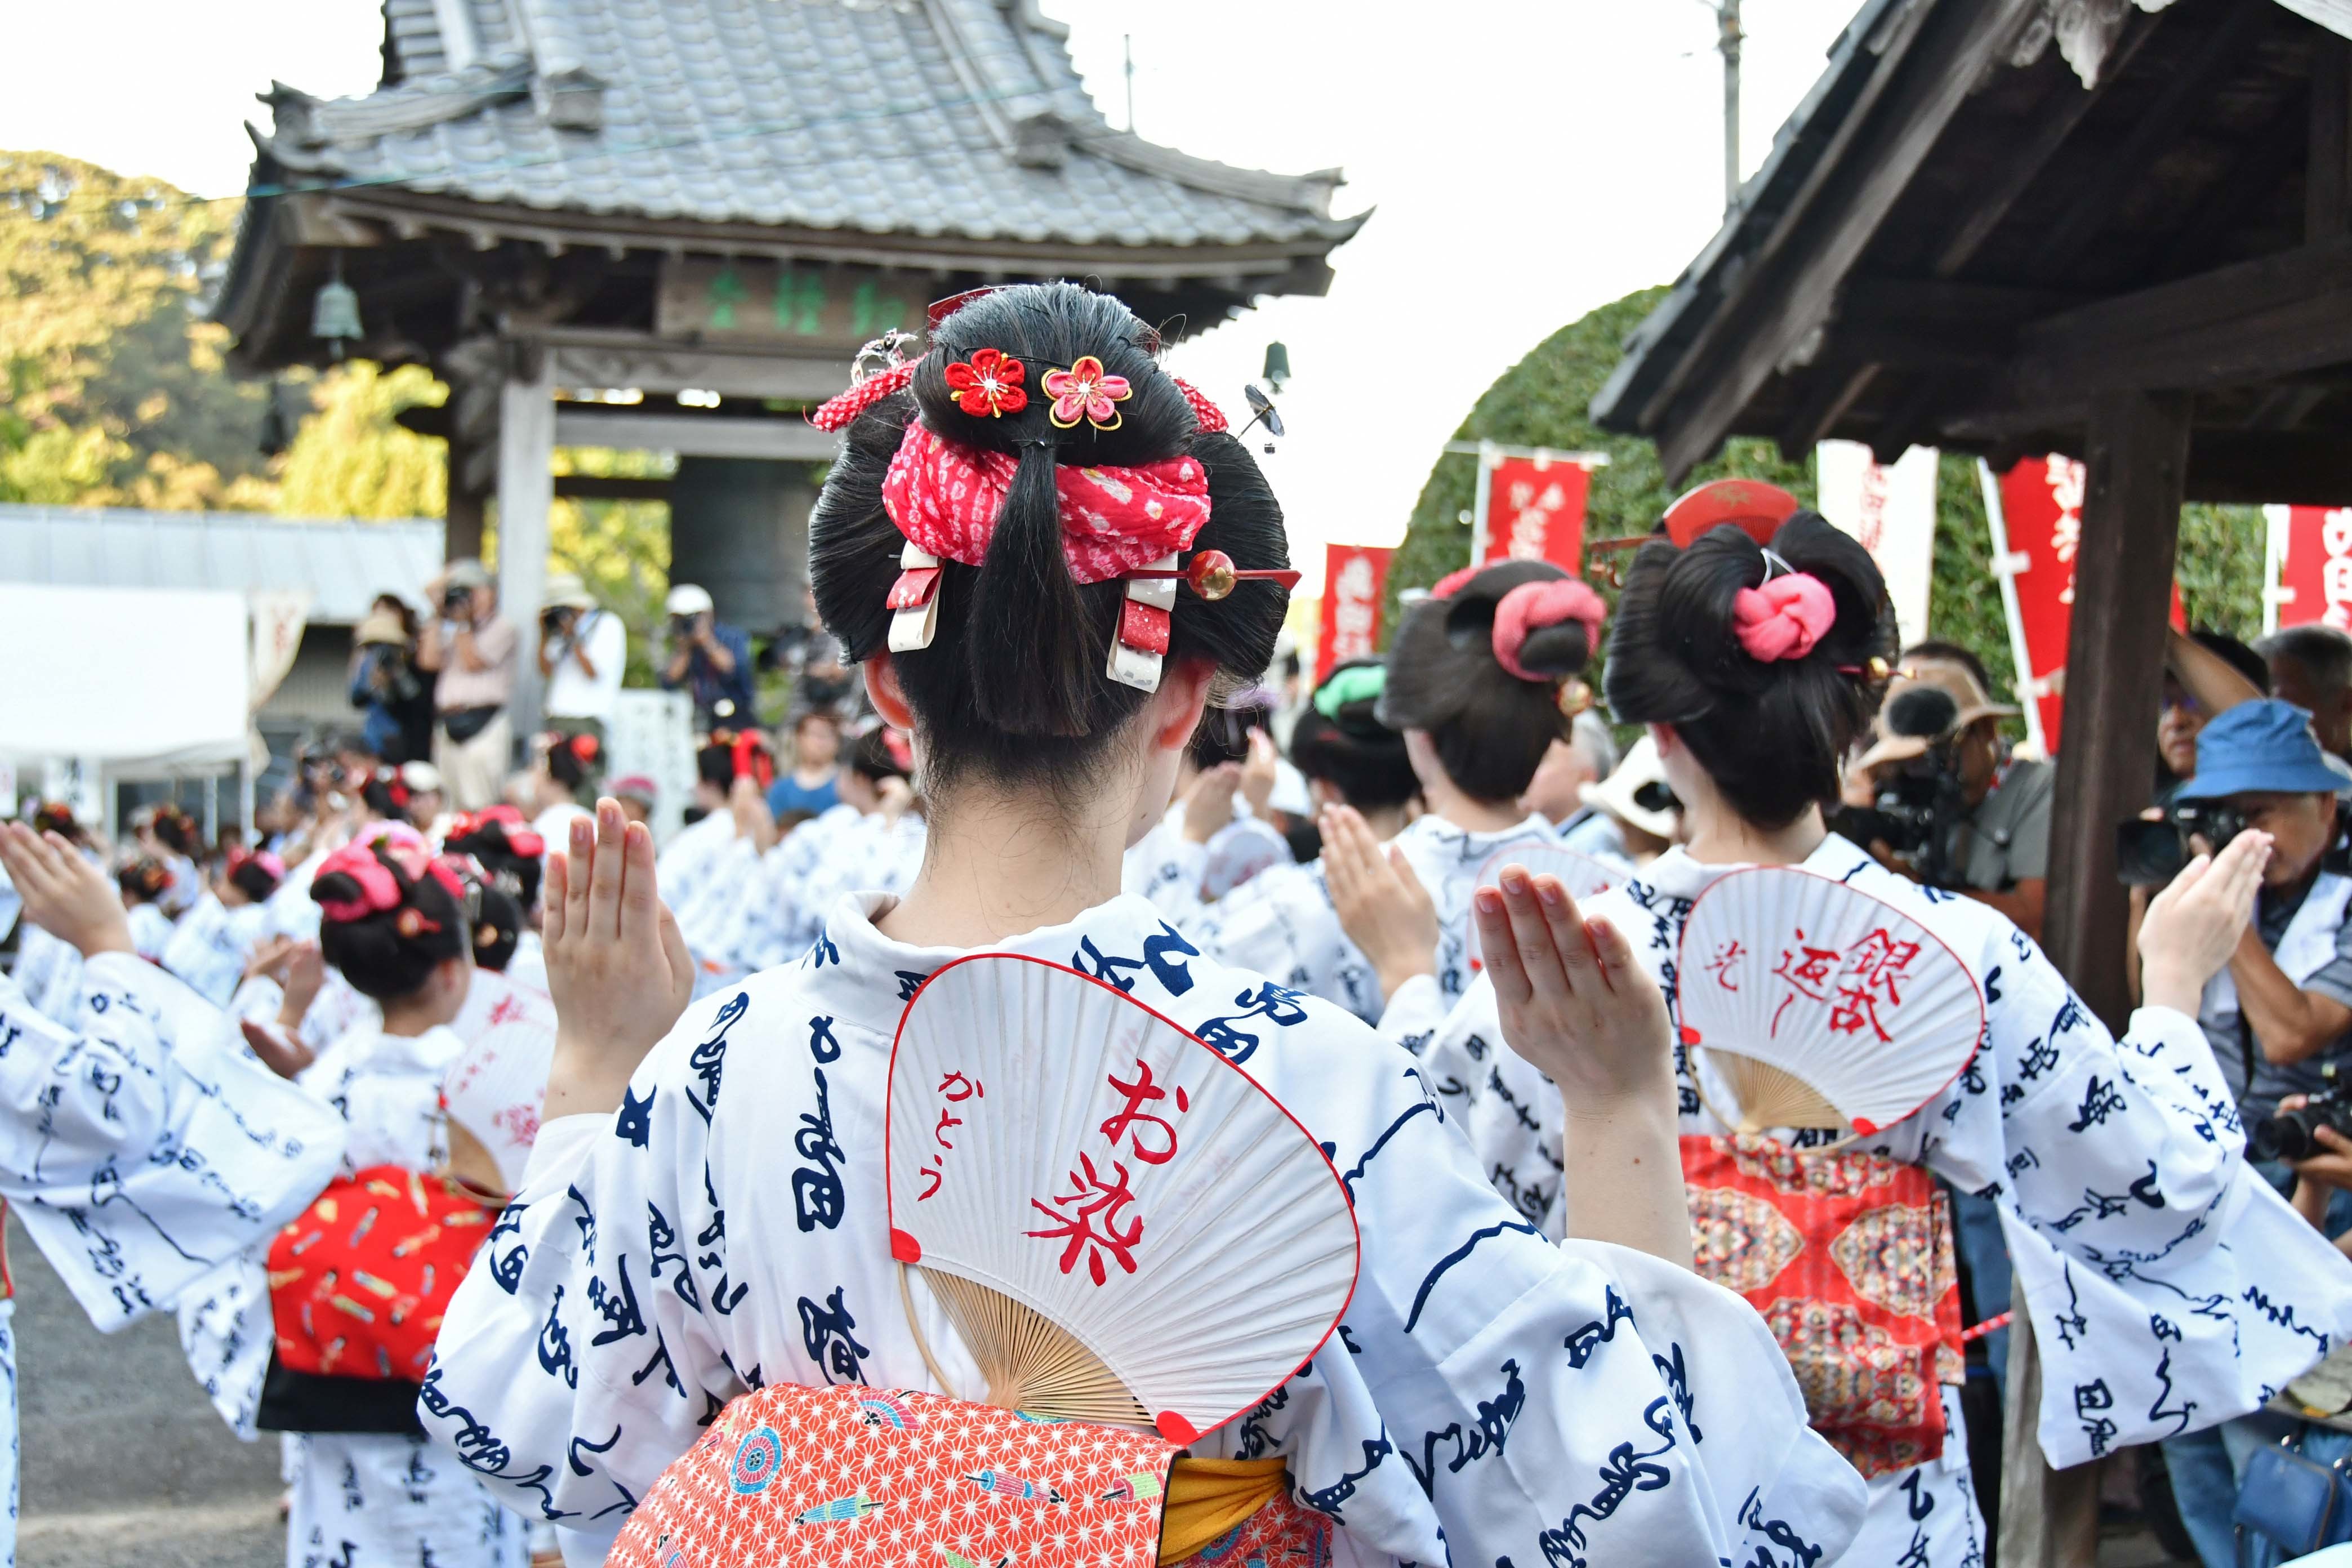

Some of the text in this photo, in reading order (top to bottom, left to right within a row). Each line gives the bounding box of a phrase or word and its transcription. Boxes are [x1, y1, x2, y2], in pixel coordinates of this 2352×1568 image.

[1829, 928, 1922, 1043] 銀杏
[918, 1070, 984, 1201] かとう
[1021, 1059, 1189, 1287] お染
